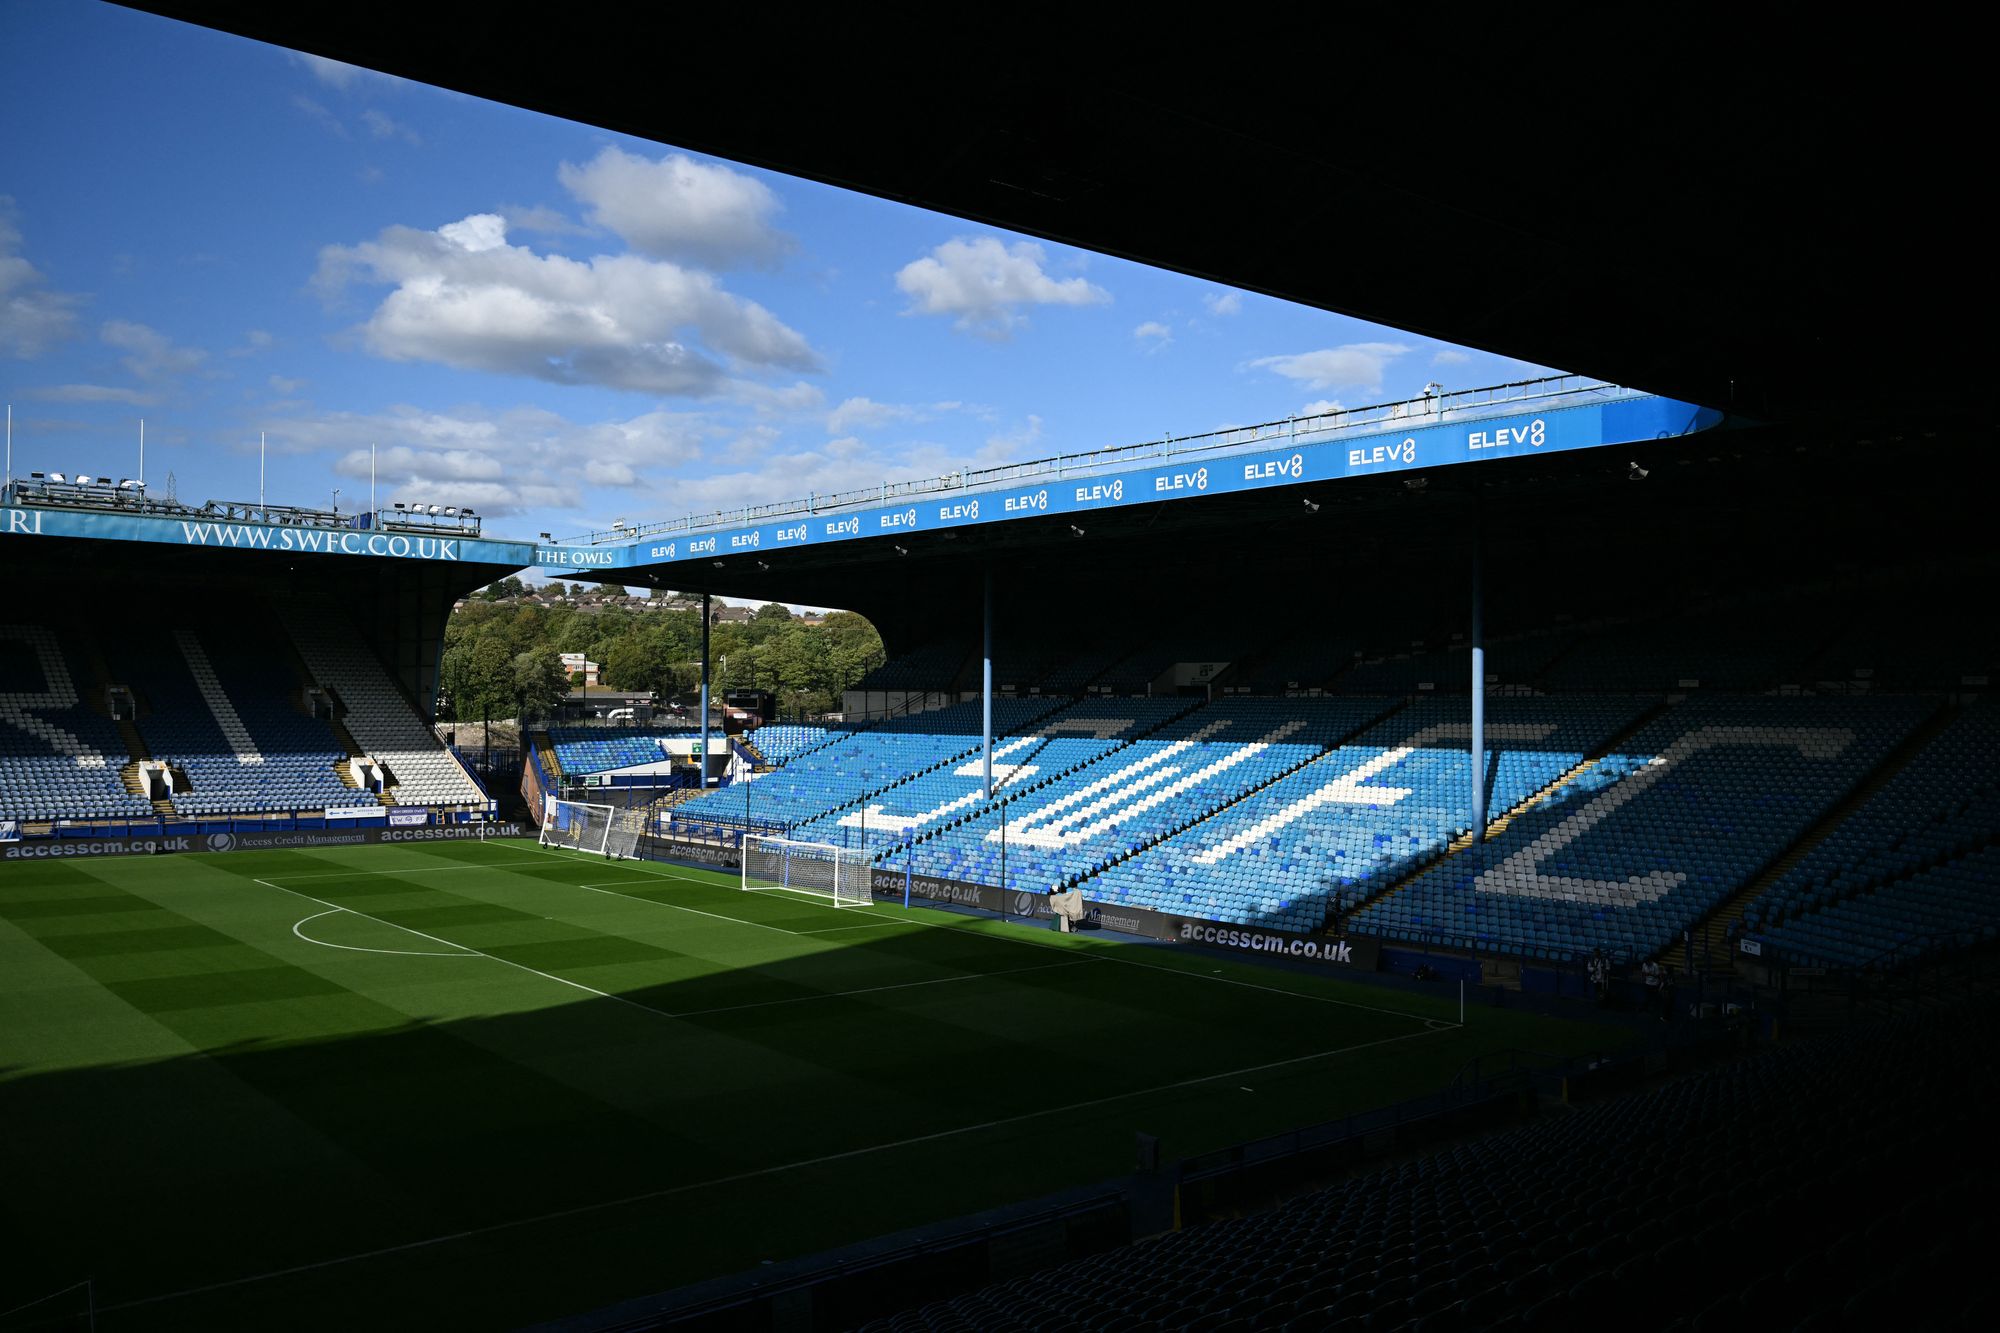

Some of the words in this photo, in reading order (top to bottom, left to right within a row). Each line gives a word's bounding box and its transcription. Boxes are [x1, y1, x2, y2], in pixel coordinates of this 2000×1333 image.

[1468, 418, 1545, 450] ELEV8
[1348, 437, 1416, 466] ELEV8
[1244, 453, 1303, 480] ELEV8
[1155, 466, 1208, 492] ELEV8
[1005, 489, 1048, 512] ELEV8
[1076, 479, 1123, 502] ELEV8
[881, 508, 916, 527] ELEV8
[940, 500, 979, 520] ELEV8
[0, 508, 43, 534] RI
[826, 516, 859, 535] ELEV8
[181, 520, 458, 561] WWW.SWFC.CO.UK
[732, 530, 760, 547] ELEV8
[777, 524, 807, 541] ELEV8
[651, 543, 676, 558] ELEV8
[690, 537, 716, 552] ELEV8
[535, 550, 568, 564] THE
[572, 551, 613, 565] OWLS
[241, 836, 273, 847] Access
[274, 835, 304, 845] Credit
[306, 833, 365, 845] Management
[381, 823, 520, 841] accesscm.co.uk
[6, 837, 190, 858] accesscm.co.uk
[873, 874, 982, 903] accescm.co.uk
[1180, 923, 1353, 963] accesscm.co.uk
